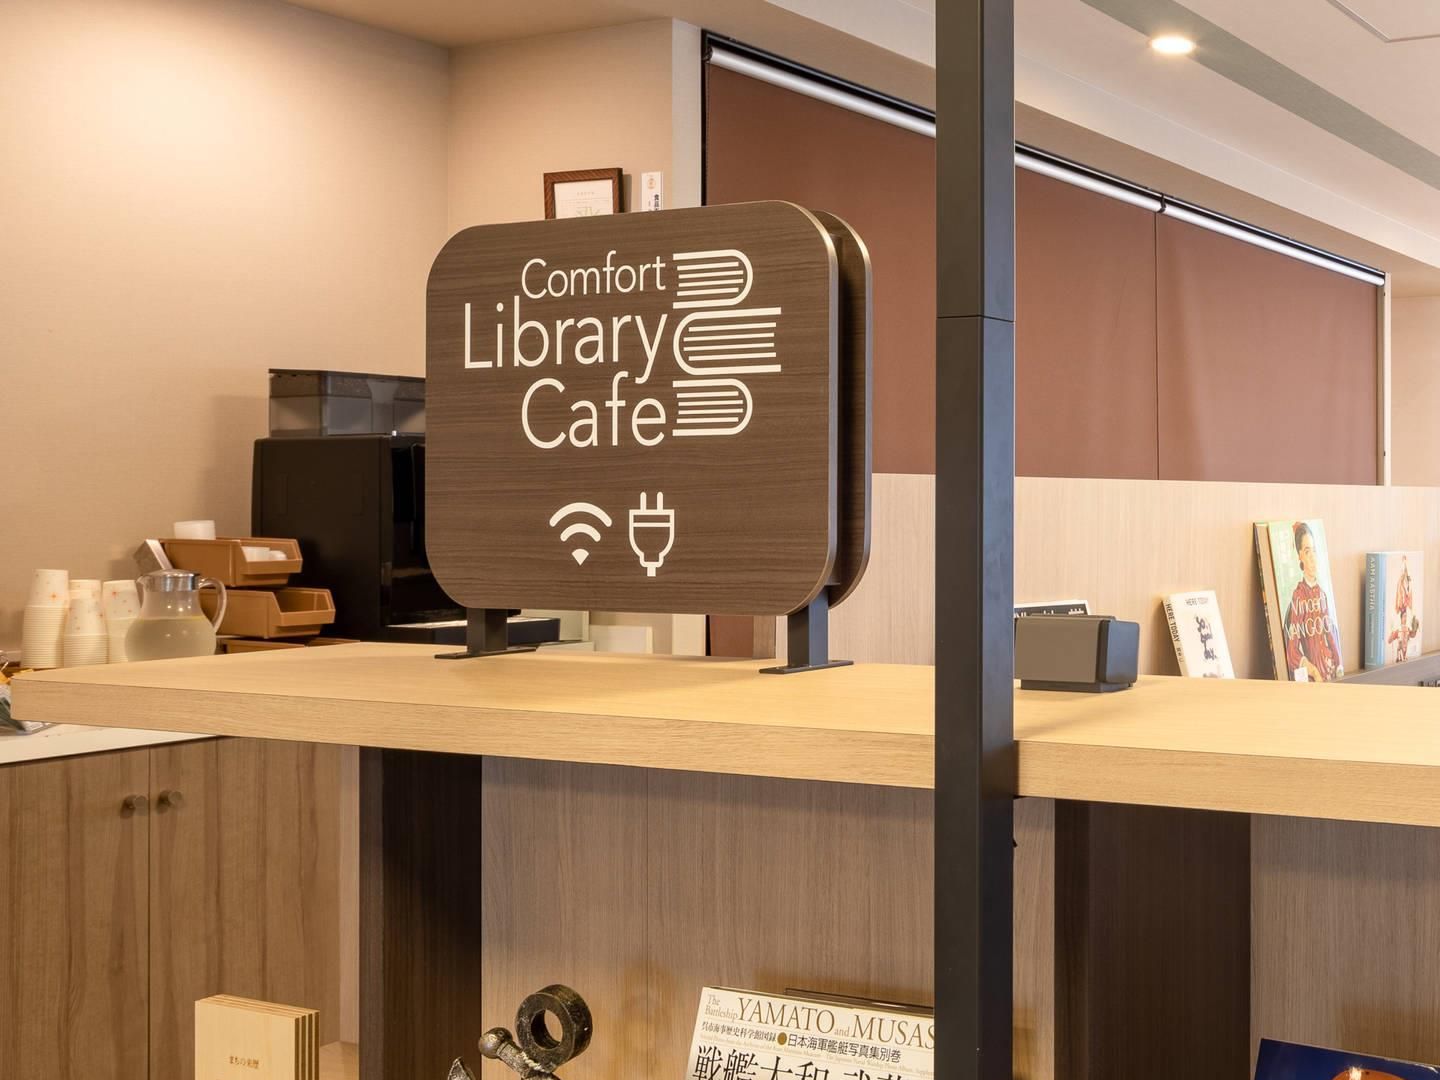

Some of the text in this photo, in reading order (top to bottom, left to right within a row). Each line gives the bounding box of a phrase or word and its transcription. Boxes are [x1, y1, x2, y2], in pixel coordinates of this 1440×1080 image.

[521, 250, 666, 299] Comfort
[464, 295, 668, 384] Library
[521, 371, 666, 449] Cafe
[1166, 603, 1174, 621] HERE
[1170, 621, 1180, 642] TODAY
[705, 1005, 738, 1022] Battleship
[708, 994, 721, 1005] The
[738, 997, 835, 1034] YAMATO
[834, 1026, 850, 1037] and
